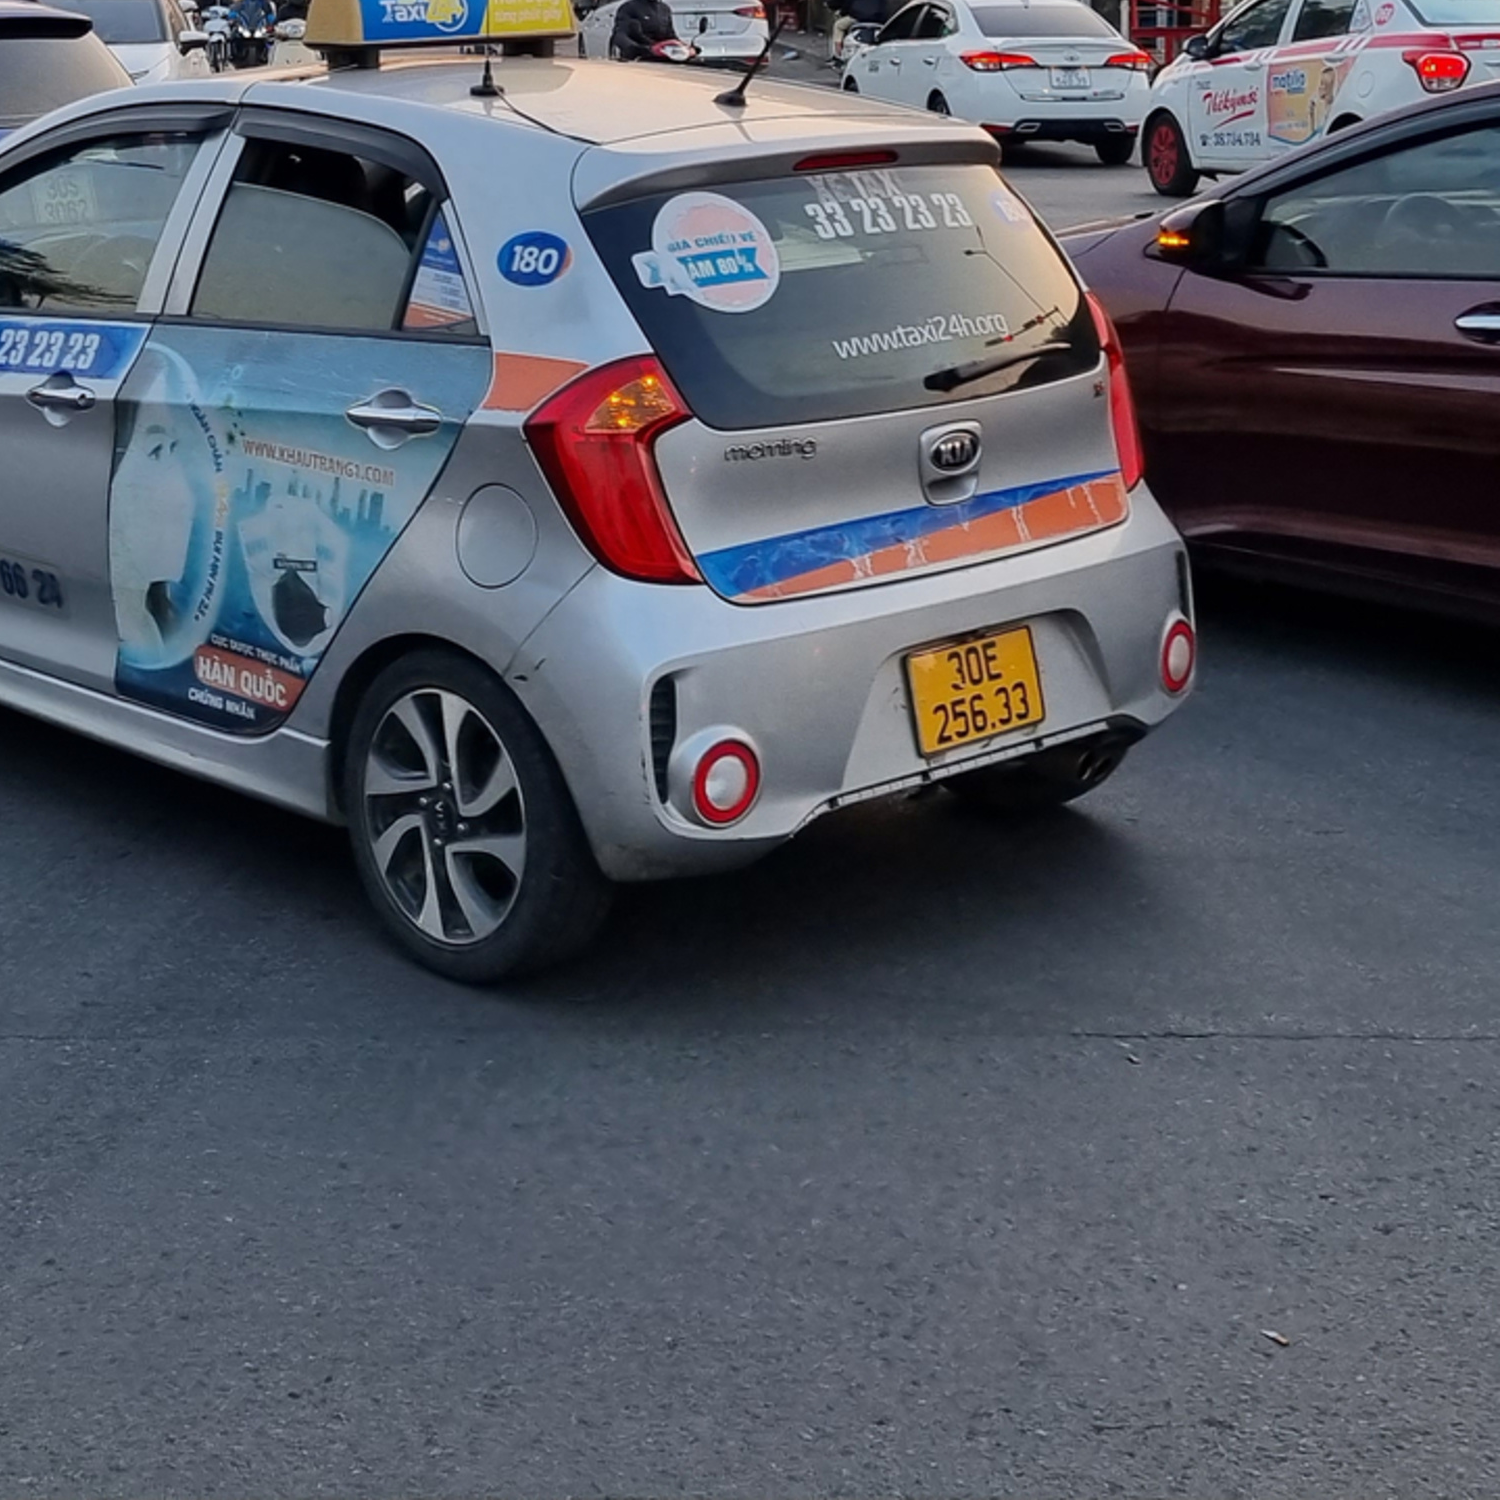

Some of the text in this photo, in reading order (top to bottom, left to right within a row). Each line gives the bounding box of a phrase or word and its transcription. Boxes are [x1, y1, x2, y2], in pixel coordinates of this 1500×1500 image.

[804, 192, 974, 239] 33 23 23 23
[510, 244, 559, 276] 180
[26, 330, 65, 368] 23
[60, 333, 100, 370] 23
[832, 311, 1010, 360] www.taxi24h.org
[938, 437, 975, 466] KIA
[198, 654, 288, 707] HÀN QUỐC
[946, 640, 1003, 691] 30E
[931, 681, 1030, 745] 256.33
